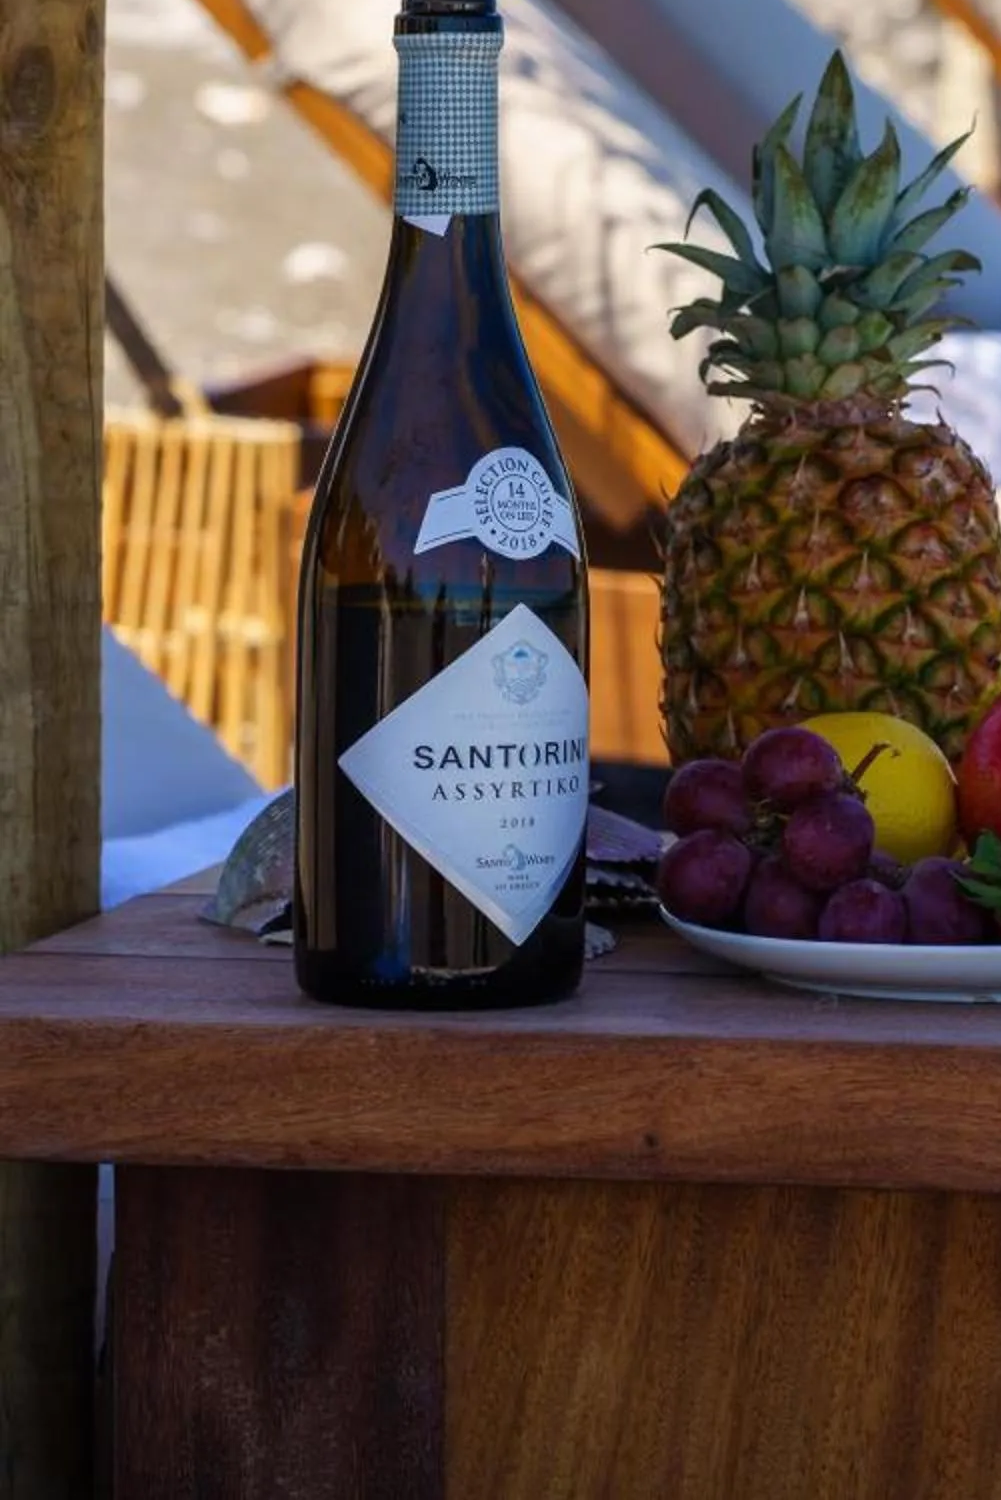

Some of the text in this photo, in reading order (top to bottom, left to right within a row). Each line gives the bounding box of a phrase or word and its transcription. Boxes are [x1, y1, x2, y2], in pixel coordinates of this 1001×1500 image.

[475, 458, 530, 524] SELECTION
[508, 481, 525, 498] 14
[499, 532, 537, 550] 2018
